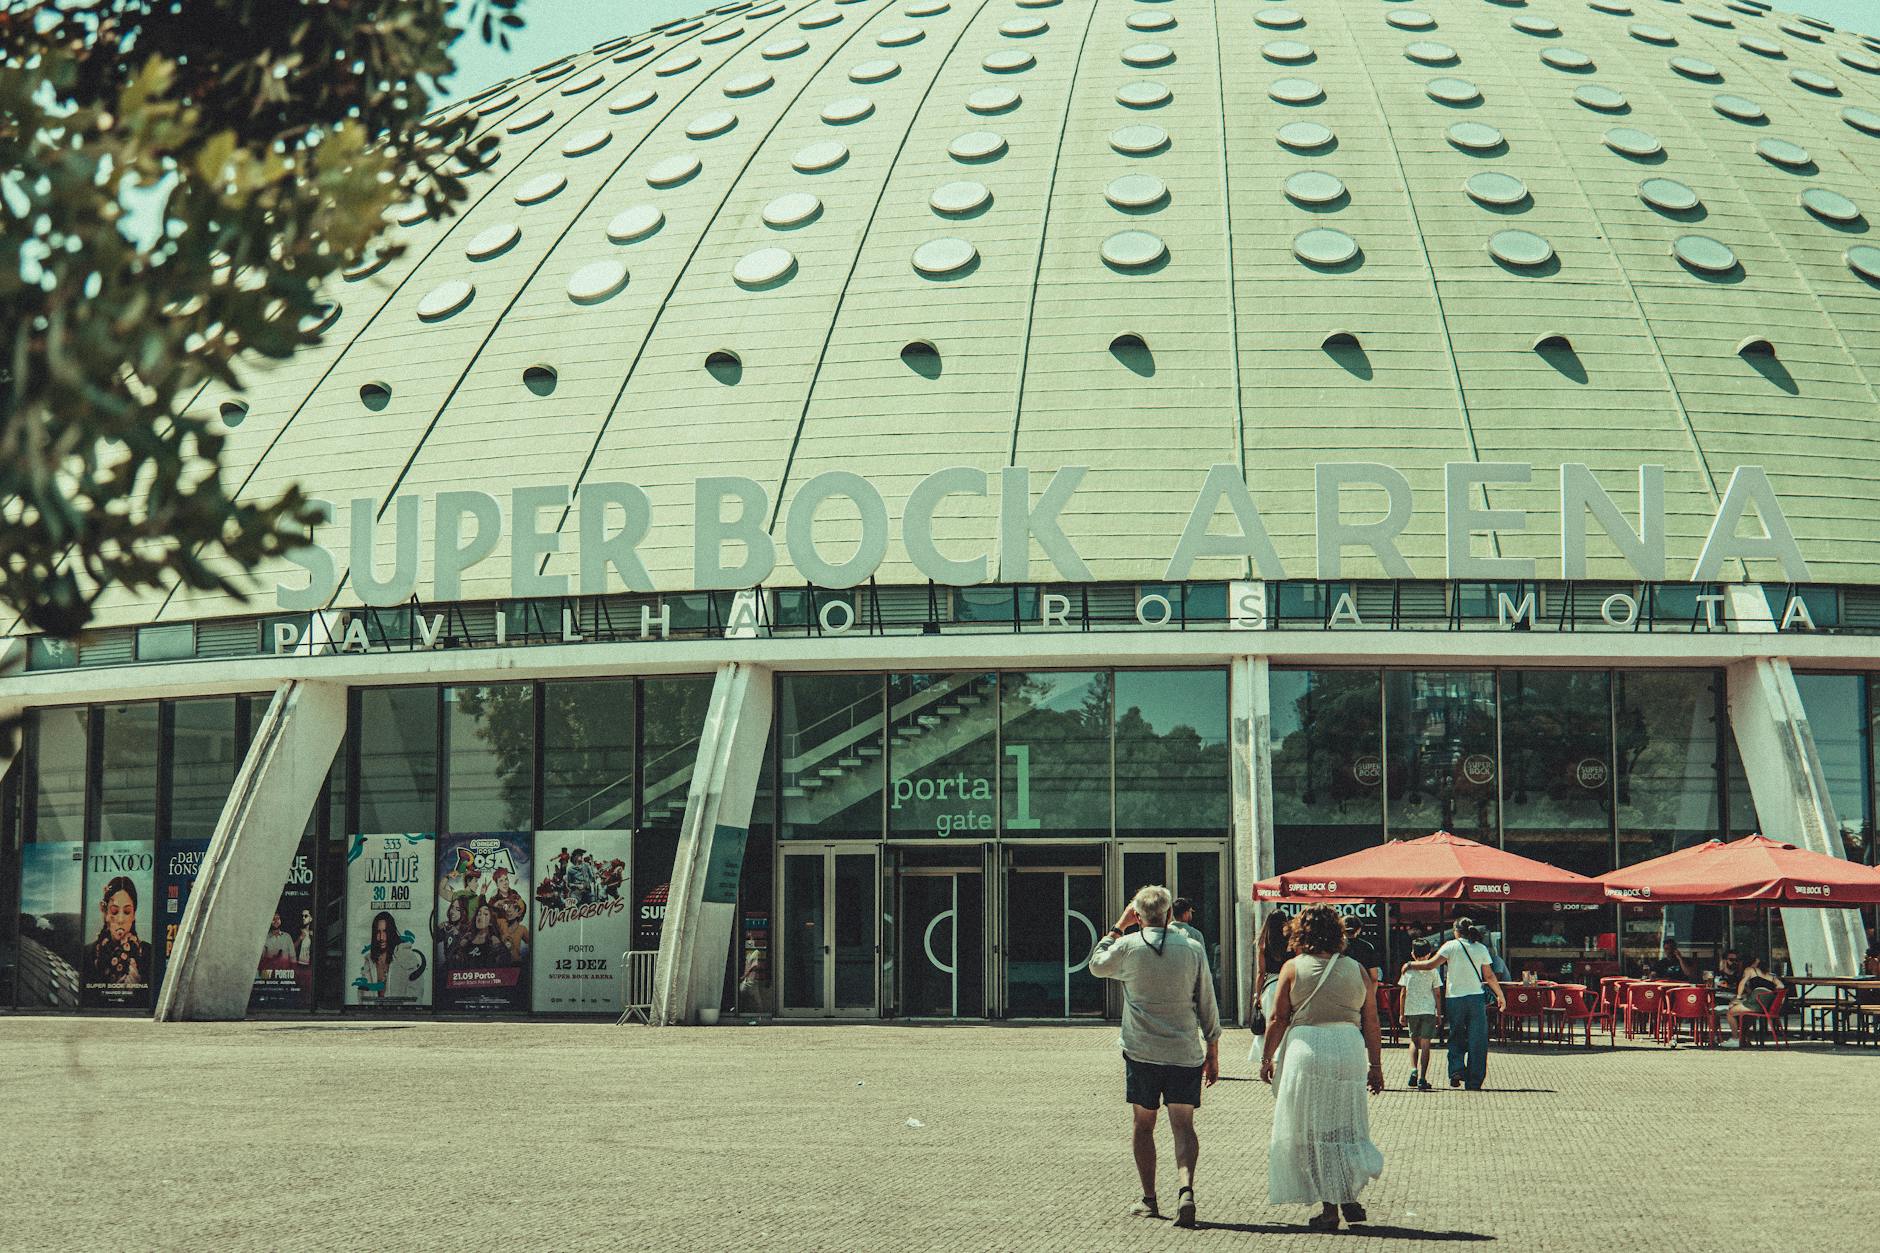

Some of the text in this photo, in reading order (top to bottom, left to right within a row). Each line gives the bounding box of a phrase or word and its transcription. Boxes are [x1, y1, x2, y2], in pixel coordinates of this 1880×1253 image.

[275, 461, 1812, 610] SUPER BOCK ARENA
[274, 590, 1816, 656] PAVILHÃO ROSA MOTA
[891, 772, 992, 809] porta
[1005, 745, 1041, 829] 1
[936, 810, 992, 837] gate
[384, 838, 401, 849] 333
[90, 853, 153, 872] TINOCO
[365, 852, 418, 883] MATUÊ
[373, 885, 410, 900] 30 AGO
[1289, 884, 1309, 892] SUPER
[1309, 883, 1327, 891] BOCK
[568, 944, 595, 953] PORTO
[555, 959, 608, 970] 12 DEZ
[274, 969, 295, 979] PORTO
[453, 971, 496, 980] 21.09 Porto
